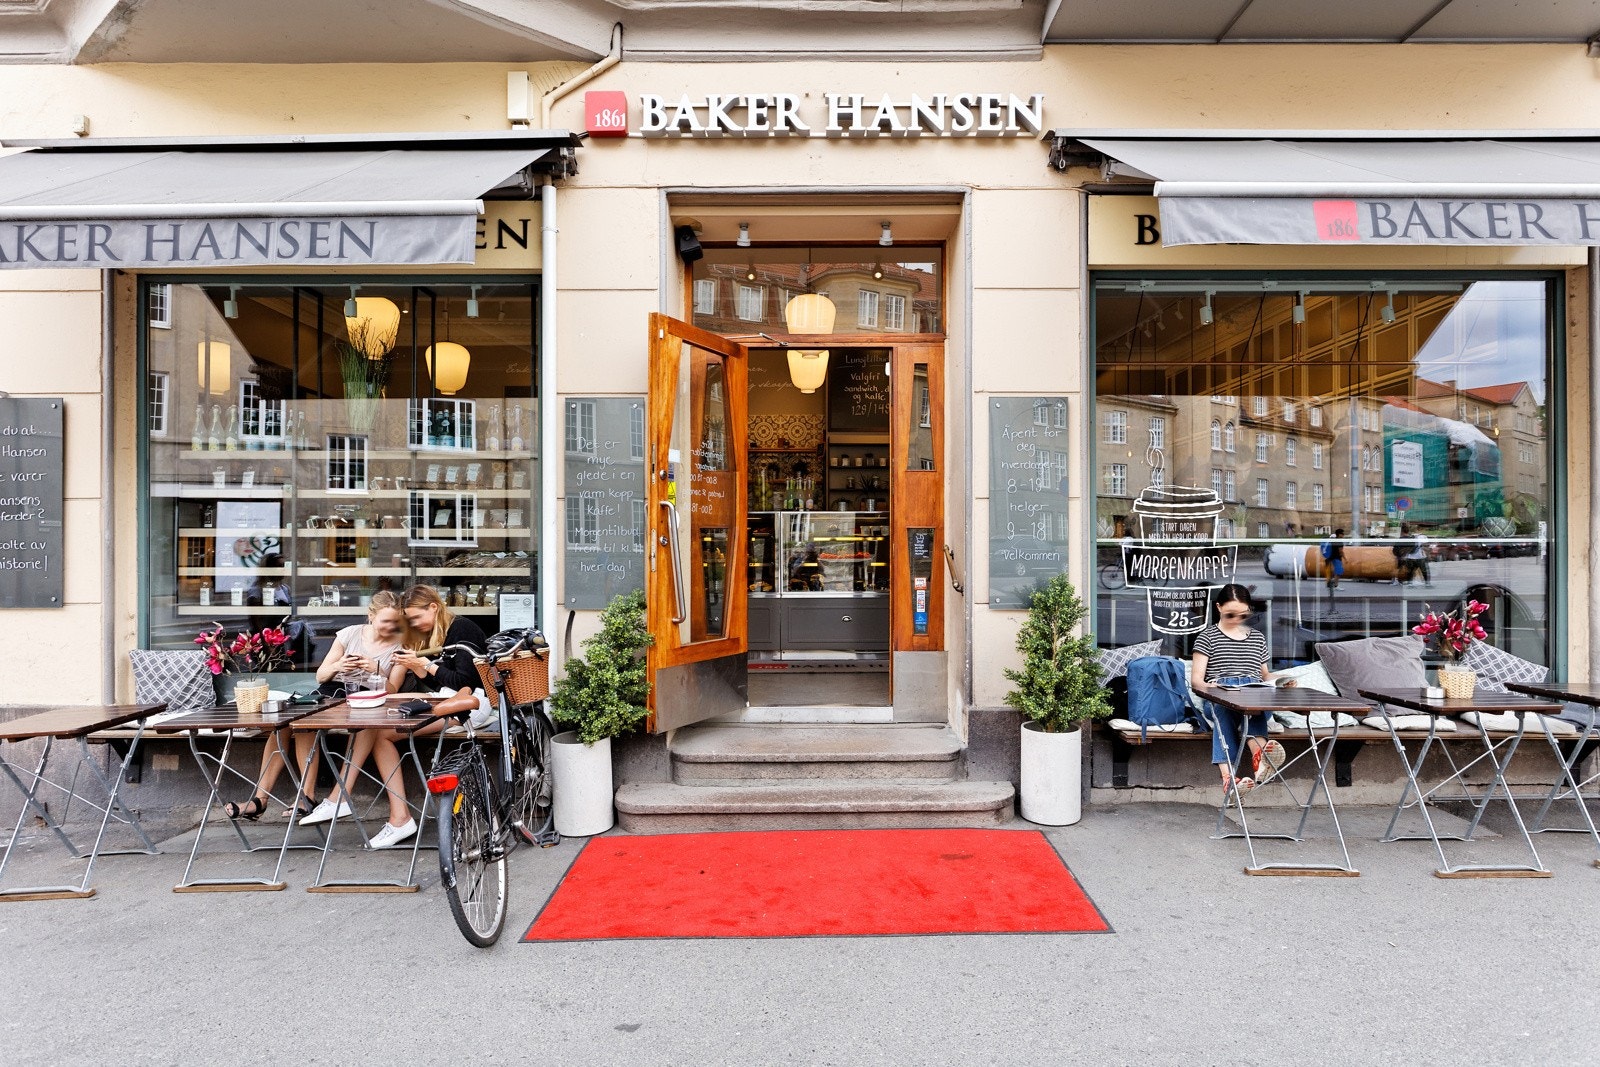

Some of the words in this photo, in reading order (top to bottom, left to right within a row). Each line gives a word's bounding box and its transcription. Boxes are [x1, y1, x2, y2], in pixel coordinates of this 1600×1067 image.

[595, 109, 626, 127] 1861
[639, 93, 811, 134] BAKER
[825, 92, 1045, 134] HANSEN
[1365, 200, 1559, 240] BAKER
[0, 223, 122, 262] KER
[141, 220, 377, 262] HANSEN
[2, 425, 18, 436] du
[1044, 426, 1062, 438] for
[2, 445, 47, 457] Hansen
[604, 440, 621, 450] er
[587, 456, 615, 470] mye
[11, 472, 47, 482] varer
[576, 470, 609, 486] glede
[620, 472, 636, 481] en
[579, 489, 605, 499] varm
[1009, 501, 1049, 518] helger
[1161, 522, 1178, 532] START
[1179, 522, 1197, 532] DAGEN
[30, 541, 46, 550] av
[580, 561, 603, 573] hver
[1130, 554, 1230, 580] MORGENKAFFE
[1152, 590, 1172, 600] MELLOM
